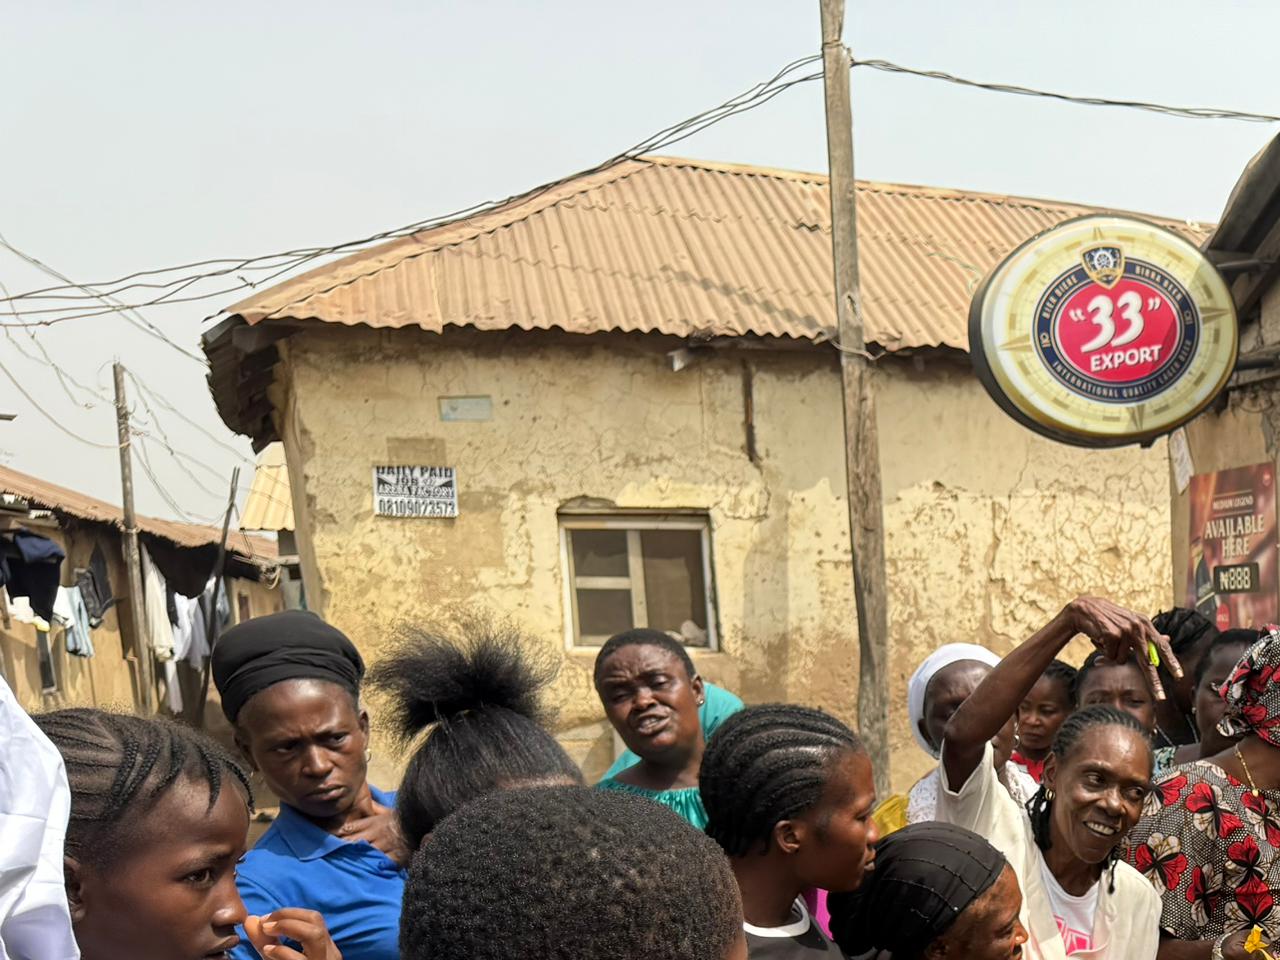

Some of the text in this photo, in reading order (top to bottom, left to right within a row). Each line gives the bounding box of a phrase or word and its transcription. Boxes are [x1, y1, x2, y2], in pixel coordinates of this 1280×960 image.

[1090, 344, 1162, 373] EXPORT
[1053, 361, 1119, 397] INTERNATIONAL
[1122, 379, 1157, 398] QUALITY
[1204, 513, 1265, 540] AVAILABLE
[1222, 535, 1250, 558] HERE
